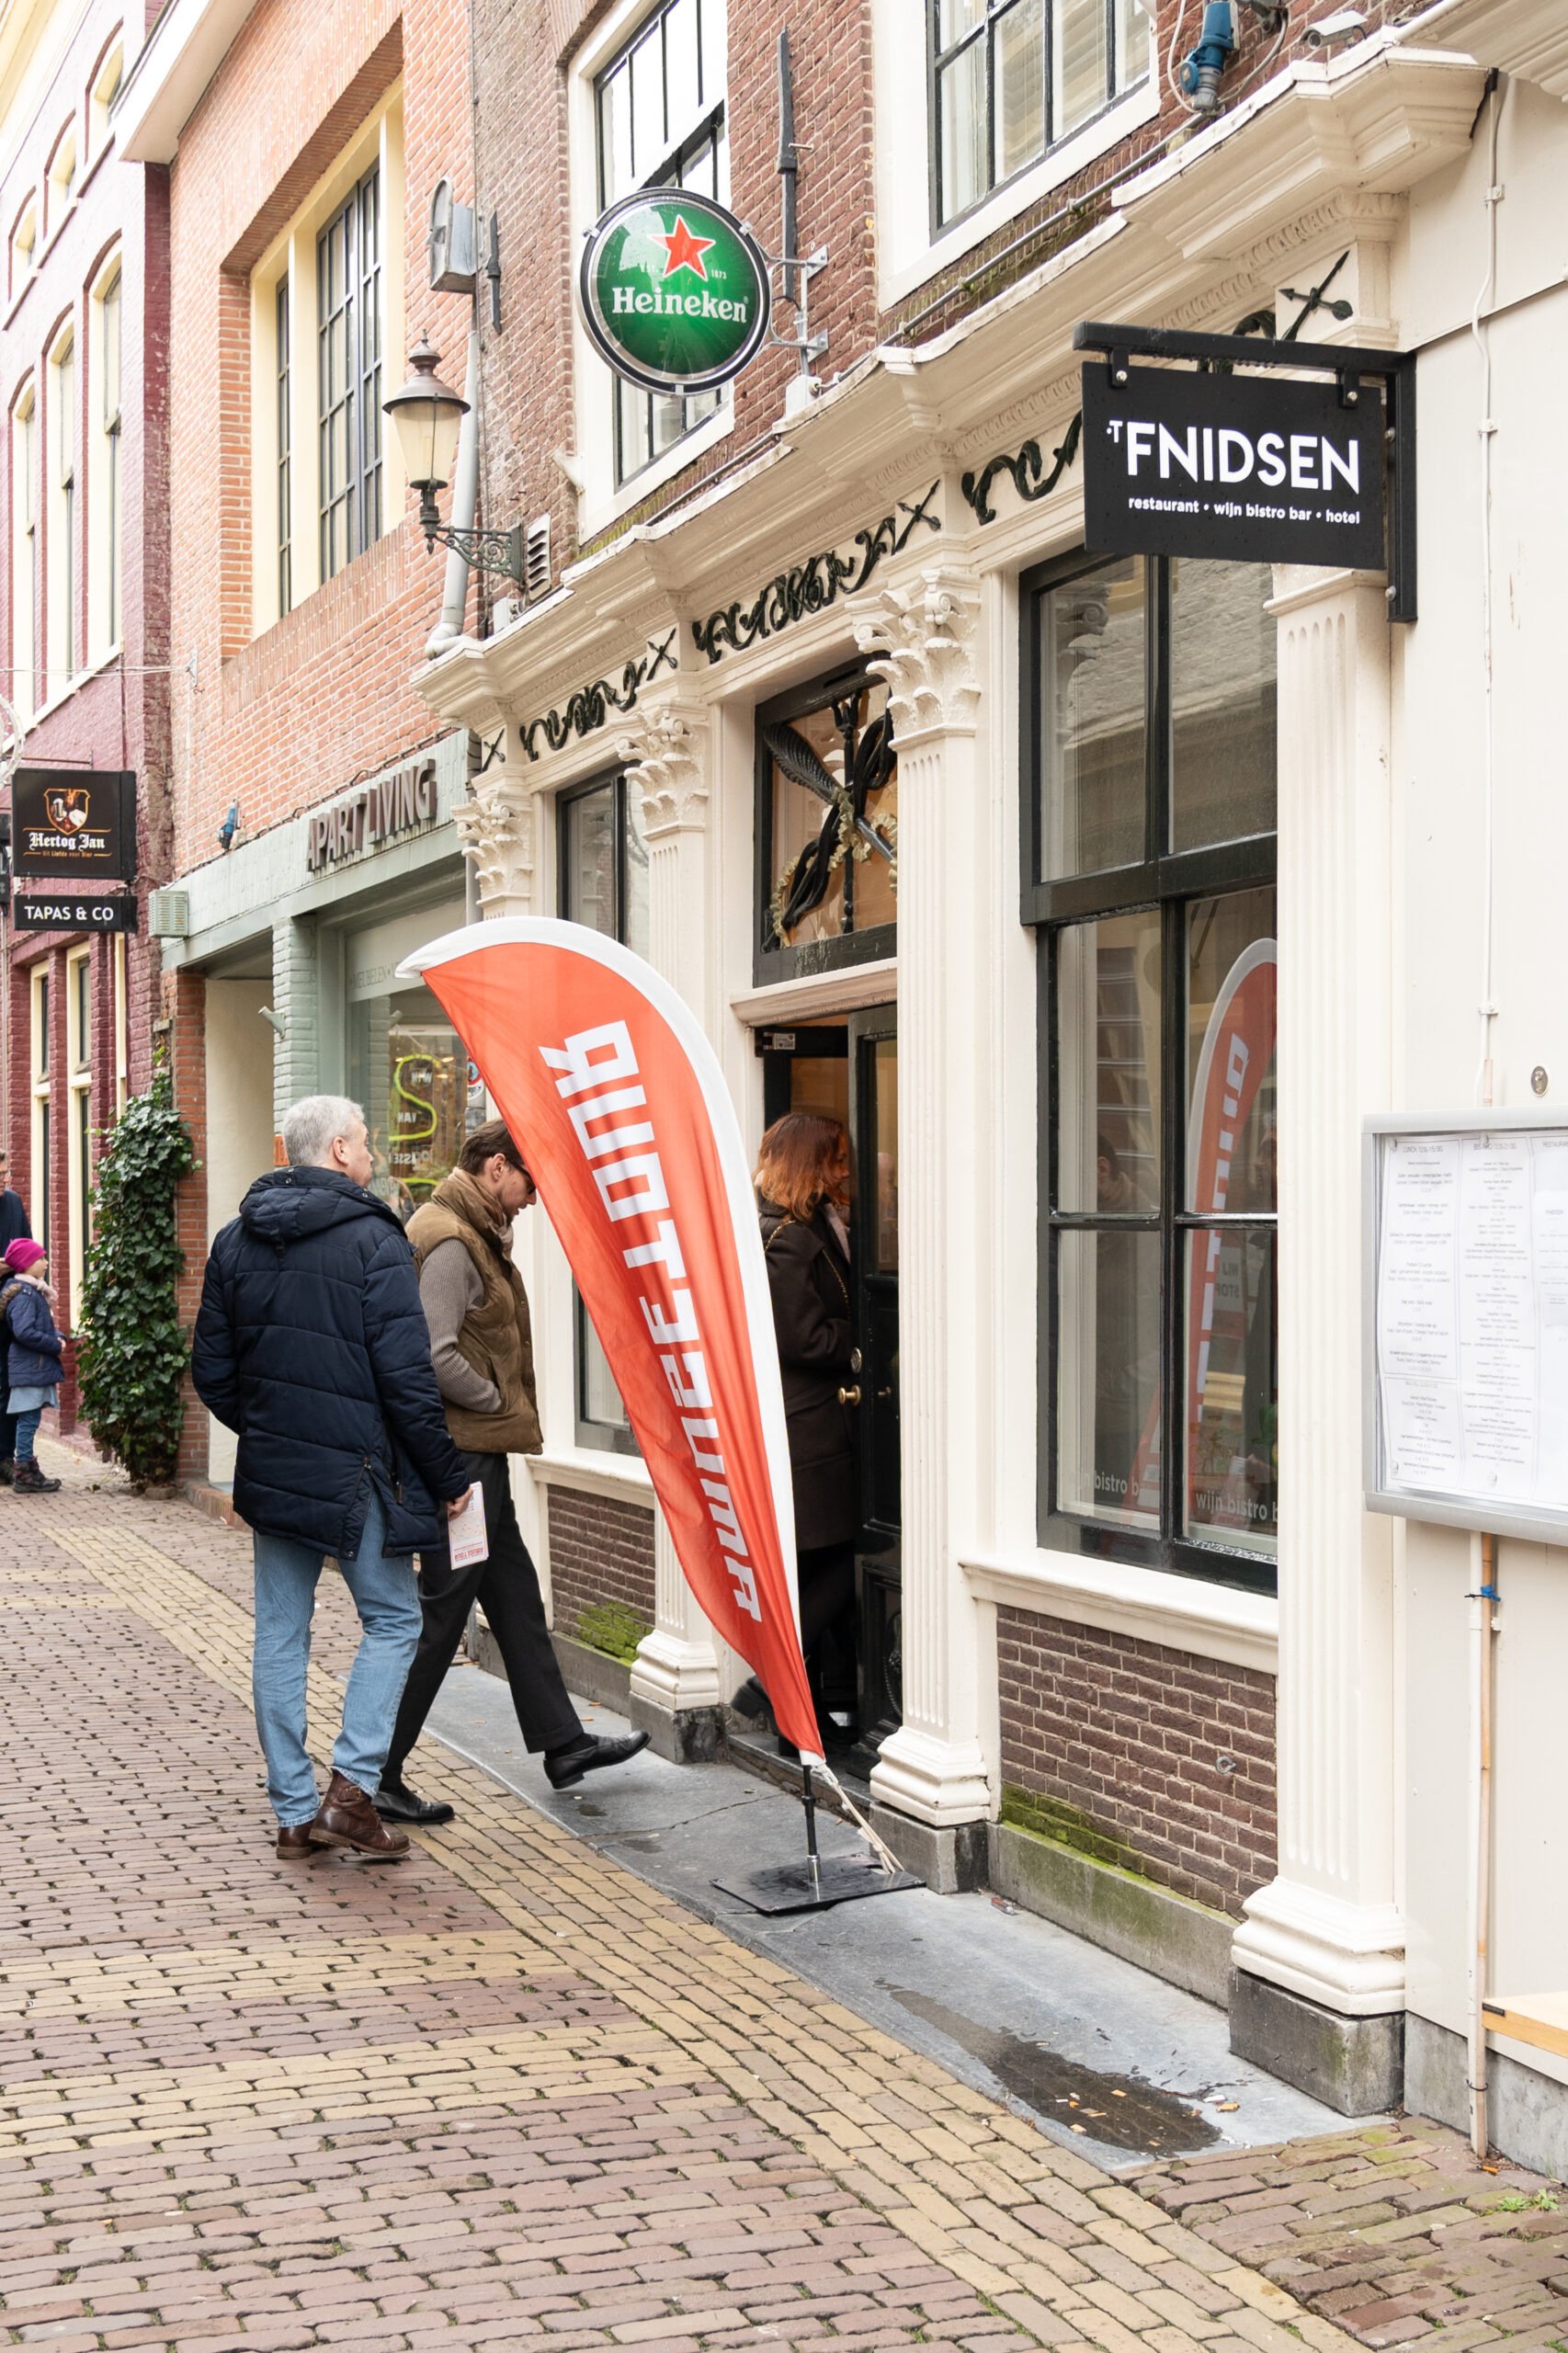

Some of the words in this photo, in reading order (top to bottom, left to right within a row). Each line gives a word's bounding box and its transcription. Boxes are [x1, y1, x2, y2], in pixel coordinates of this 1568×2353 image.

[612, 286, 747, 324] Heineken
[1127, 421, 1359, 494] FNIDSEN
[1129, 496, 1199, 514] restaurant
[1214, 502, 1243, 517] wijn
[1245, 503, 1286, 519] bistro
[1289, 506, 1312, 521] bar
[1325, 510, 1360, 525] hotel
[307, 792, 368, 872] APART
[367, 758, 437, 846] LIVING
[28, 832, 76, 851] Hertog
[77, 834, 106, 852] Jan
[24, 905, 71, 920] TAPAS
[75, 906, 88, 921] &
[92, 906, 114, 921] CO
[1094, 1470, 1129, 1495] bistro
[1196, 1489, 1223, 1514] wijn
[1226, 1492, 1268, 1523] bistro
